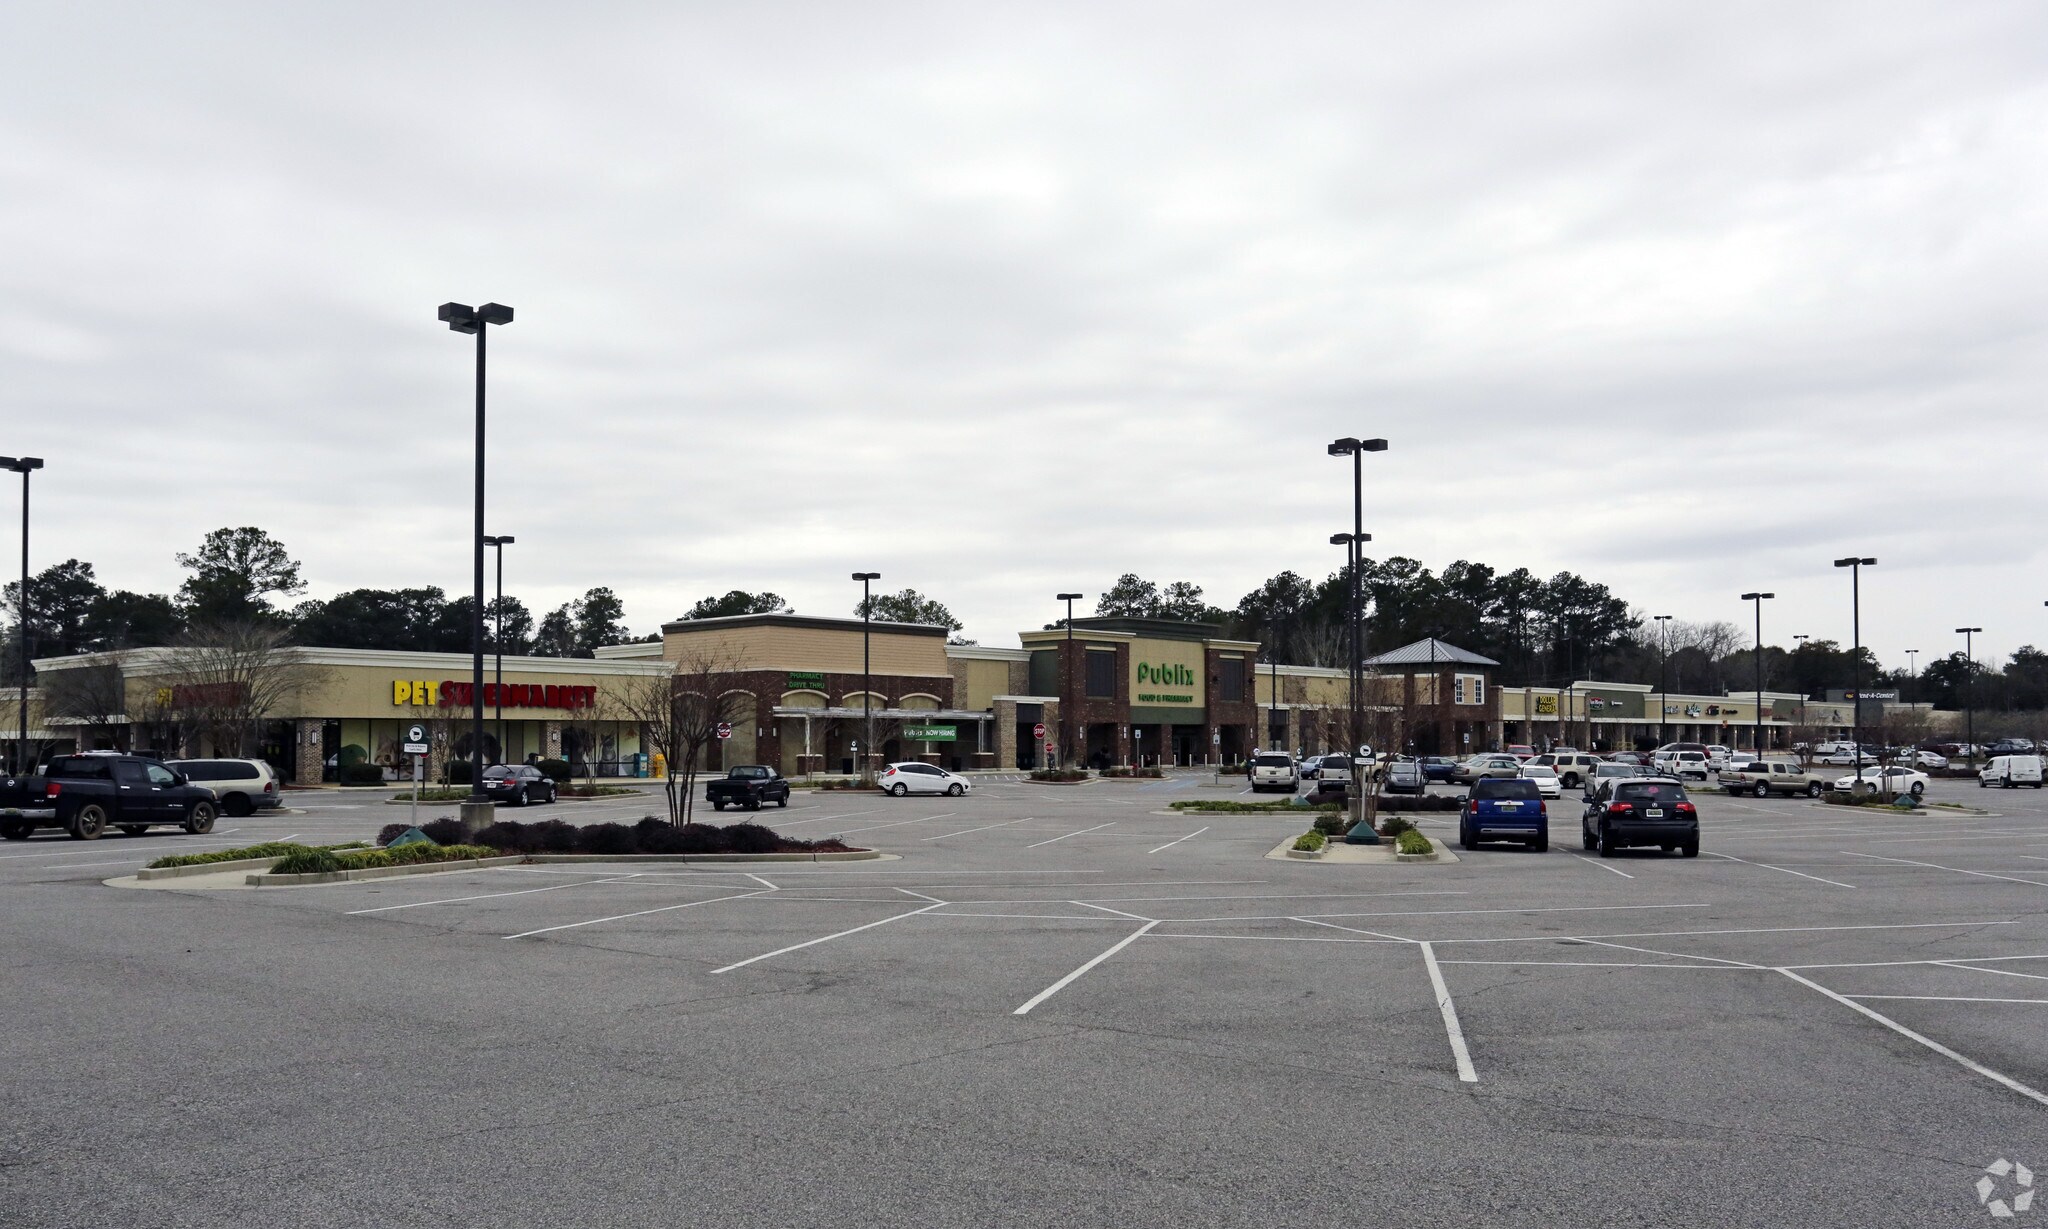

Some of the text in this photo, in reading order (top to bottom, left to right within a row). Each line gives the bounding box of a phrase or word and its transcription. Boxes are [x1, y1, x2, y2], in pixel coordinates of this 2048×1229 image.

[789, 672, 823, 680] PHARMACY
[1138, 662, 1194, 685] Publix
[788, 681, 807, 689] DRIVE
[392, 680, 597, 710] PET SUERMARKET
[1138, 693, 1156, 702] FOOD
[1162, 694, 1194, 703] PHARMACY
[1538, 696, 1556, 704] DOLLAR
[1537, 704, 1556, 713] GENERAL
